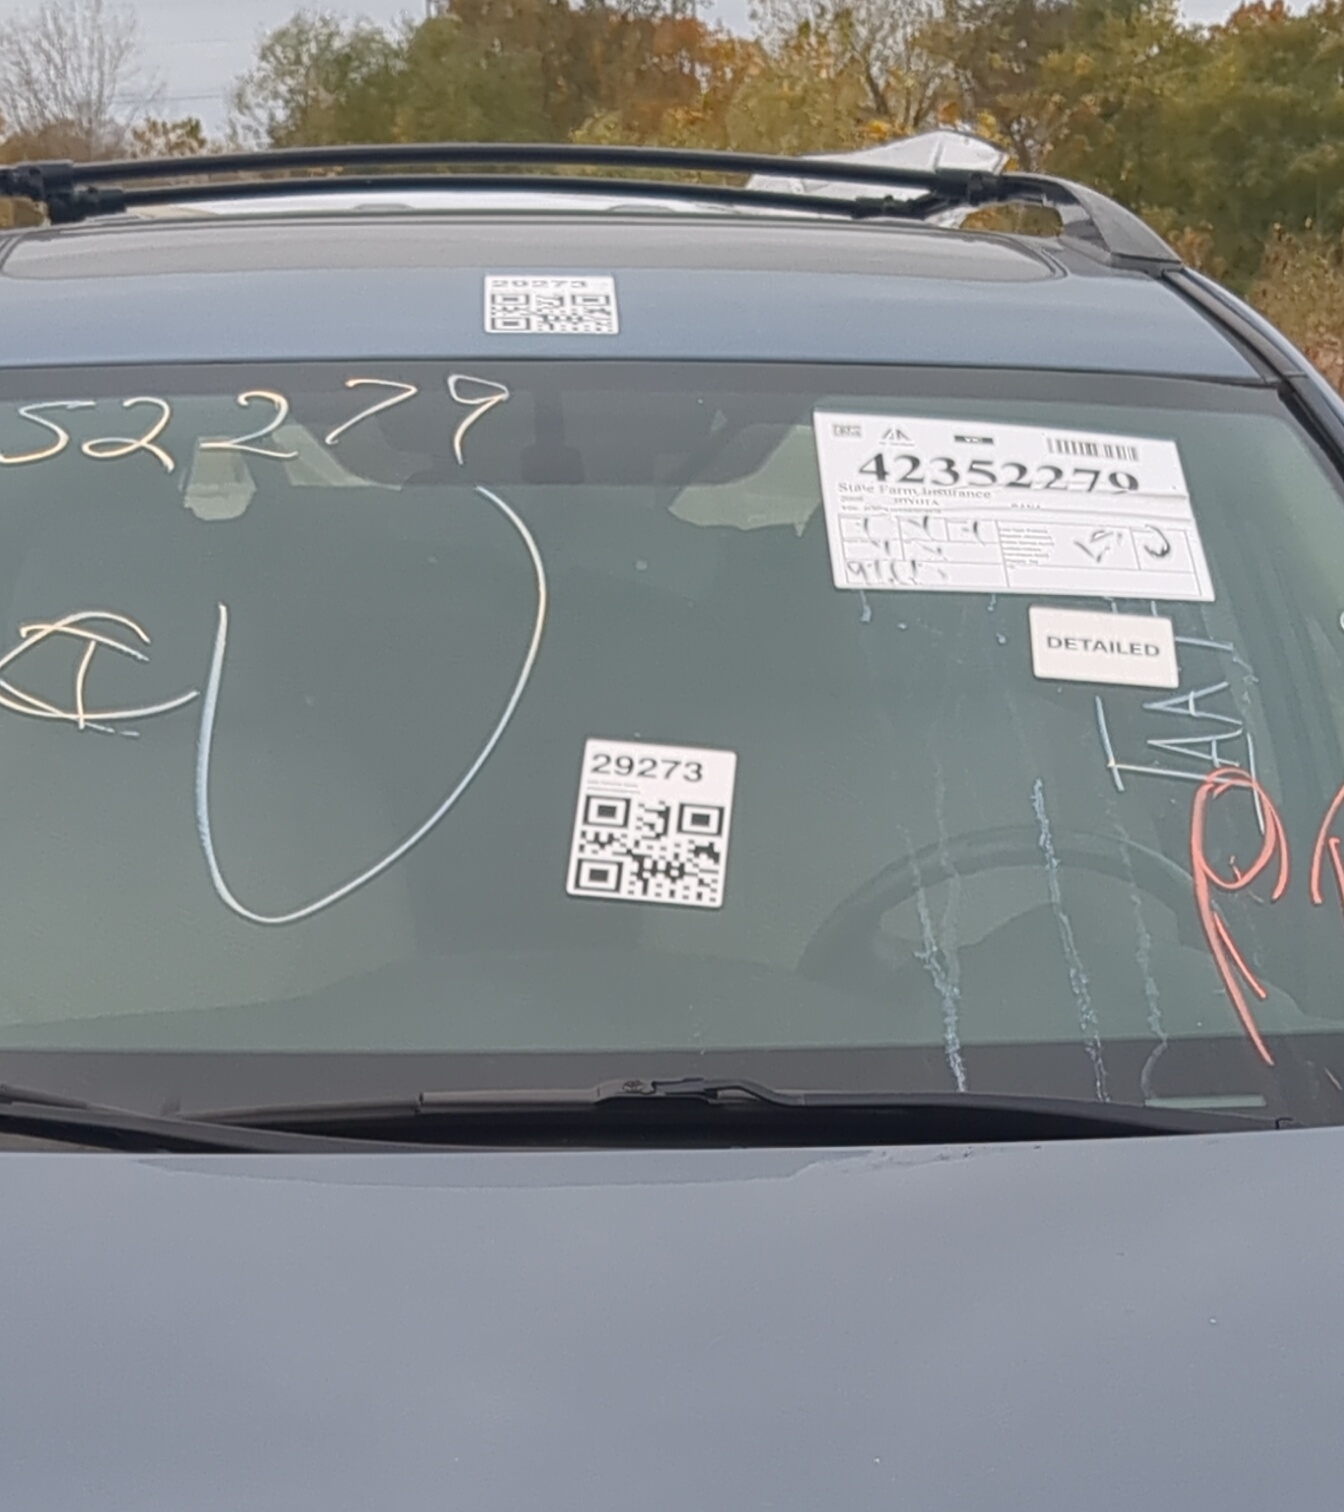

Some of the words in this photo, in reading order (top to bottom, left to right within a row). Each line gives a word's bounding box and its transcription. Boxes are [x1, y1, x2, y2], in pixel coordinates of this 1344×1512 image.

[491, 280, 587, 288] 29273
[858, 451, 1140, 493] 42352279
[838, 482, 875, 493] State
[922, 487, 991, 499] Insurance
[1046, 635, 1161, 658] DETAILED
[590, 753, 704, 783] 29273
